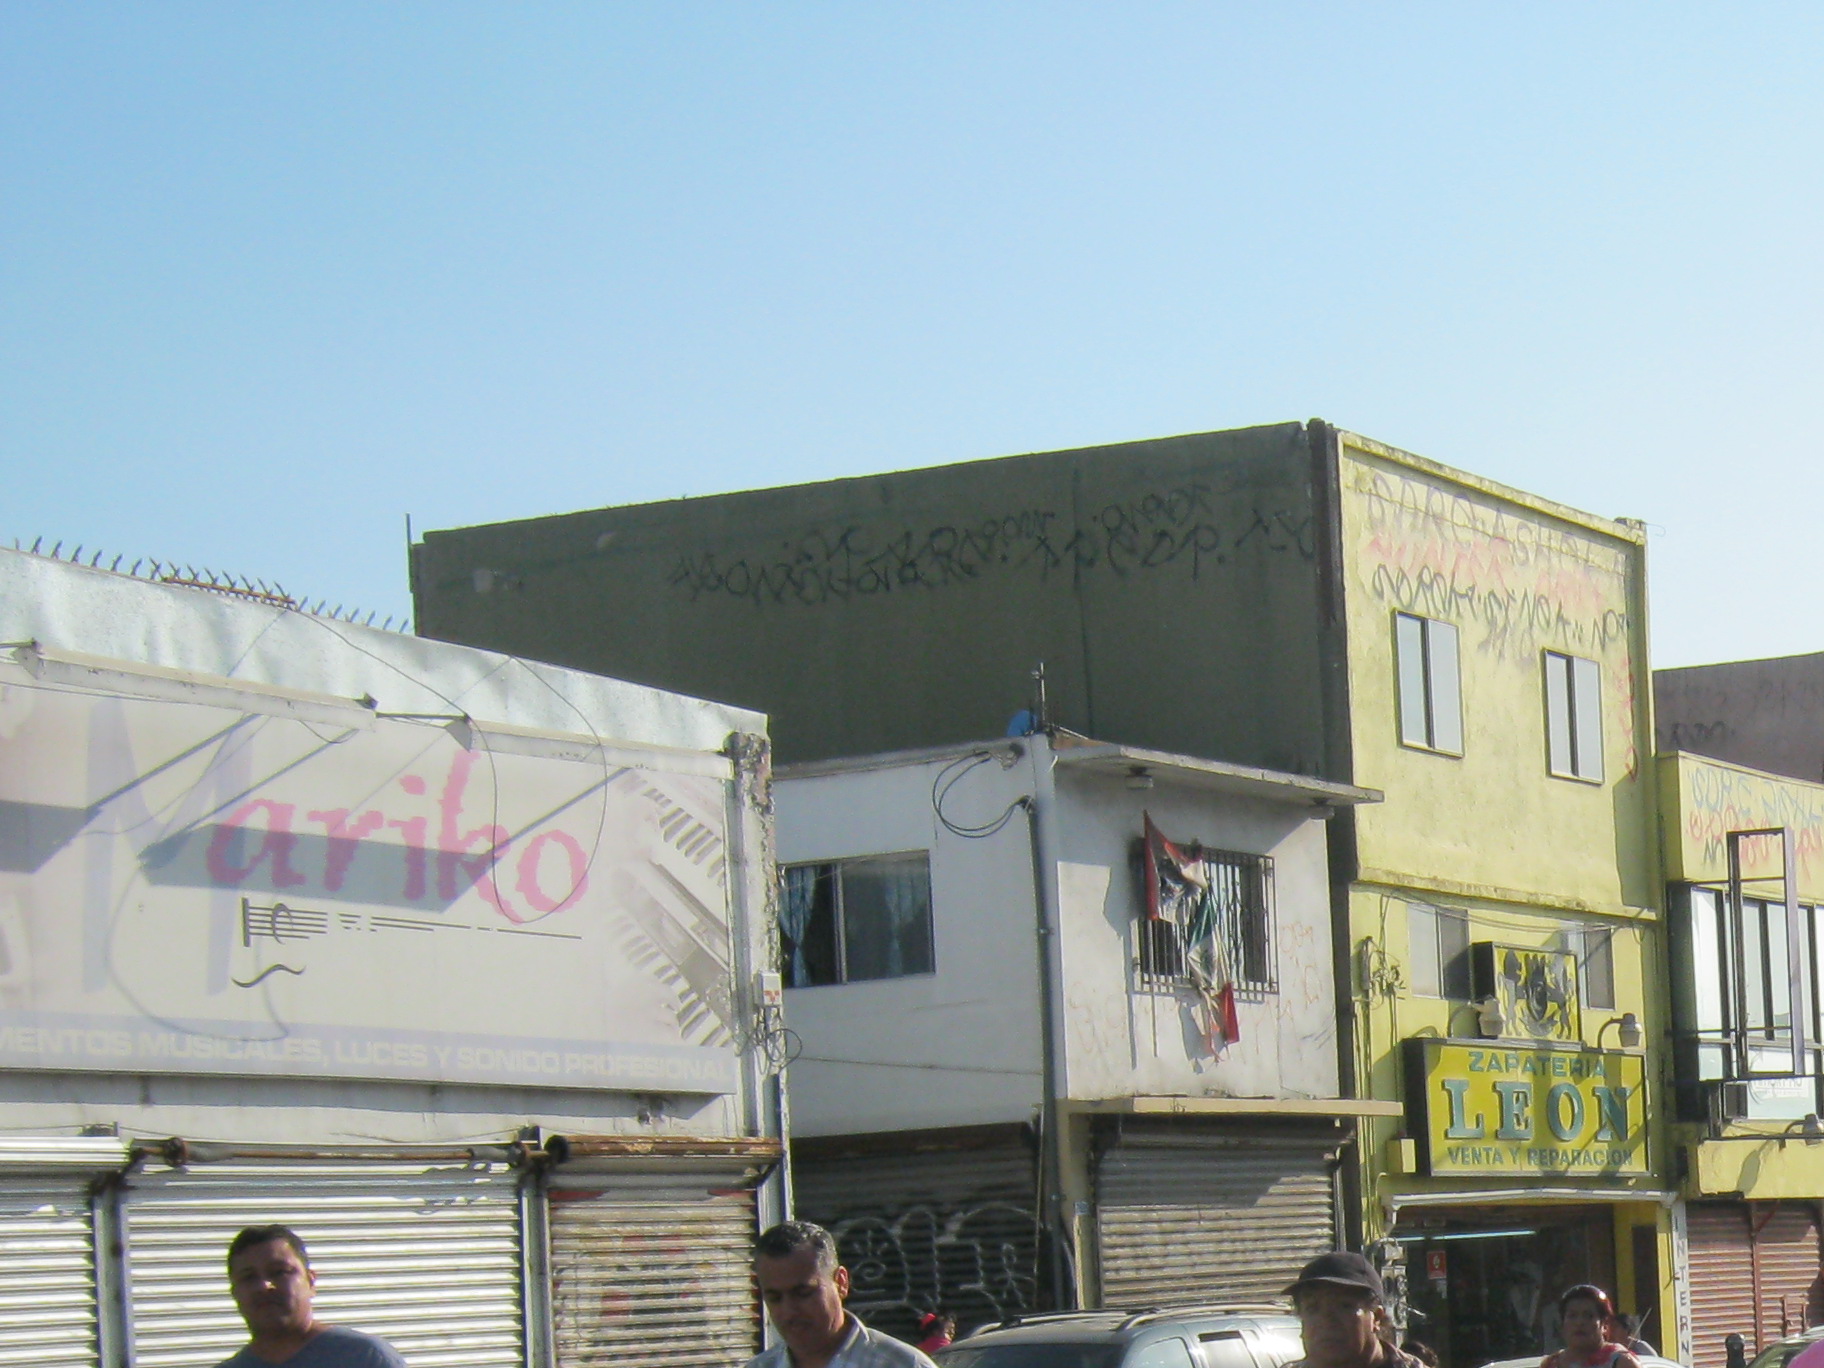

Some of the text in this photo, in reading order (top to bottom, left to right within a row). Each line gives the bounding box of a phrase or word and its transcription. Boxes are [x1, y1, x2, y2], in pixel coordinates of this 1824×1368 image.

[82, 700, 590, 994] Mariko
[336, 1040, 426, 1067] LUCES
[433, 1046, 453, 1068] Y
[457, 1047, 561, 1074] SONIDO
[564, 1053, 732, 1081] PROFESIONAL
[1468, 1051, 1607, 1078] ZAPATERIA
[1441, 1078, 1632, 1142] LEON
[1447, 1147, 1633, 1166] VENTA Y REPARACION
[1674, 1205, 1692, 1368] INTERN
